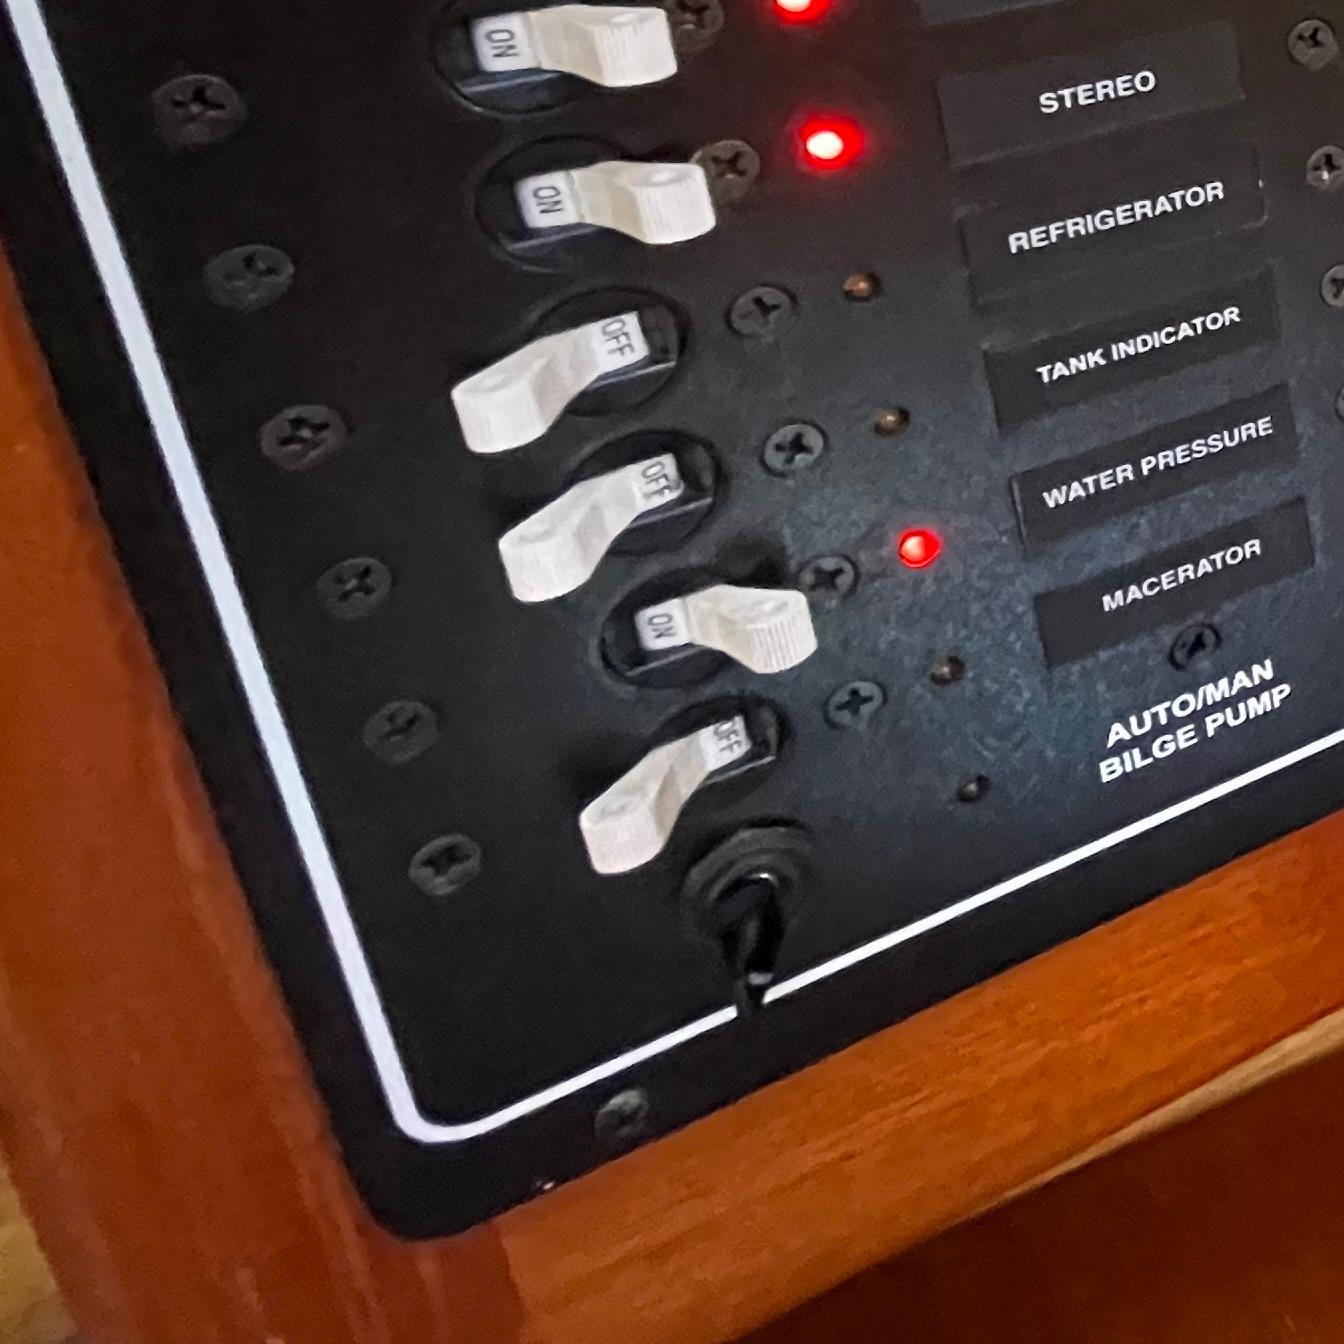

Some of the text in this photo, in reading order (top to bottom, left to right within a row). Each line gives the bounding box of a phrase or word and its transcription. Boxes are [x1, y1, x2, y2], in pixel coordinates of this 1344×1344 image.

[486, 26, 516, 59] ON
[1039, 70, 1157, 114] STEREO
[531, 185, 563, 217] ON
[1007, 180, 1226, 255] REFRIGERATOR
[601, 316, 635, 358] OFF
[1036, 306, 1242, 385] TANK INDICATOR
[640, 459, 674, 499] OFF
[1042, 417, 1275, 509] WATER PRESSURE
[1101, 539, 1263, 613] MACERATOR
[646, 612, 675, 641] ON
[1106, 658, 1277, 748] AUTO/MAN
[1099, 682, 1292, 785] BILGE PUMP
